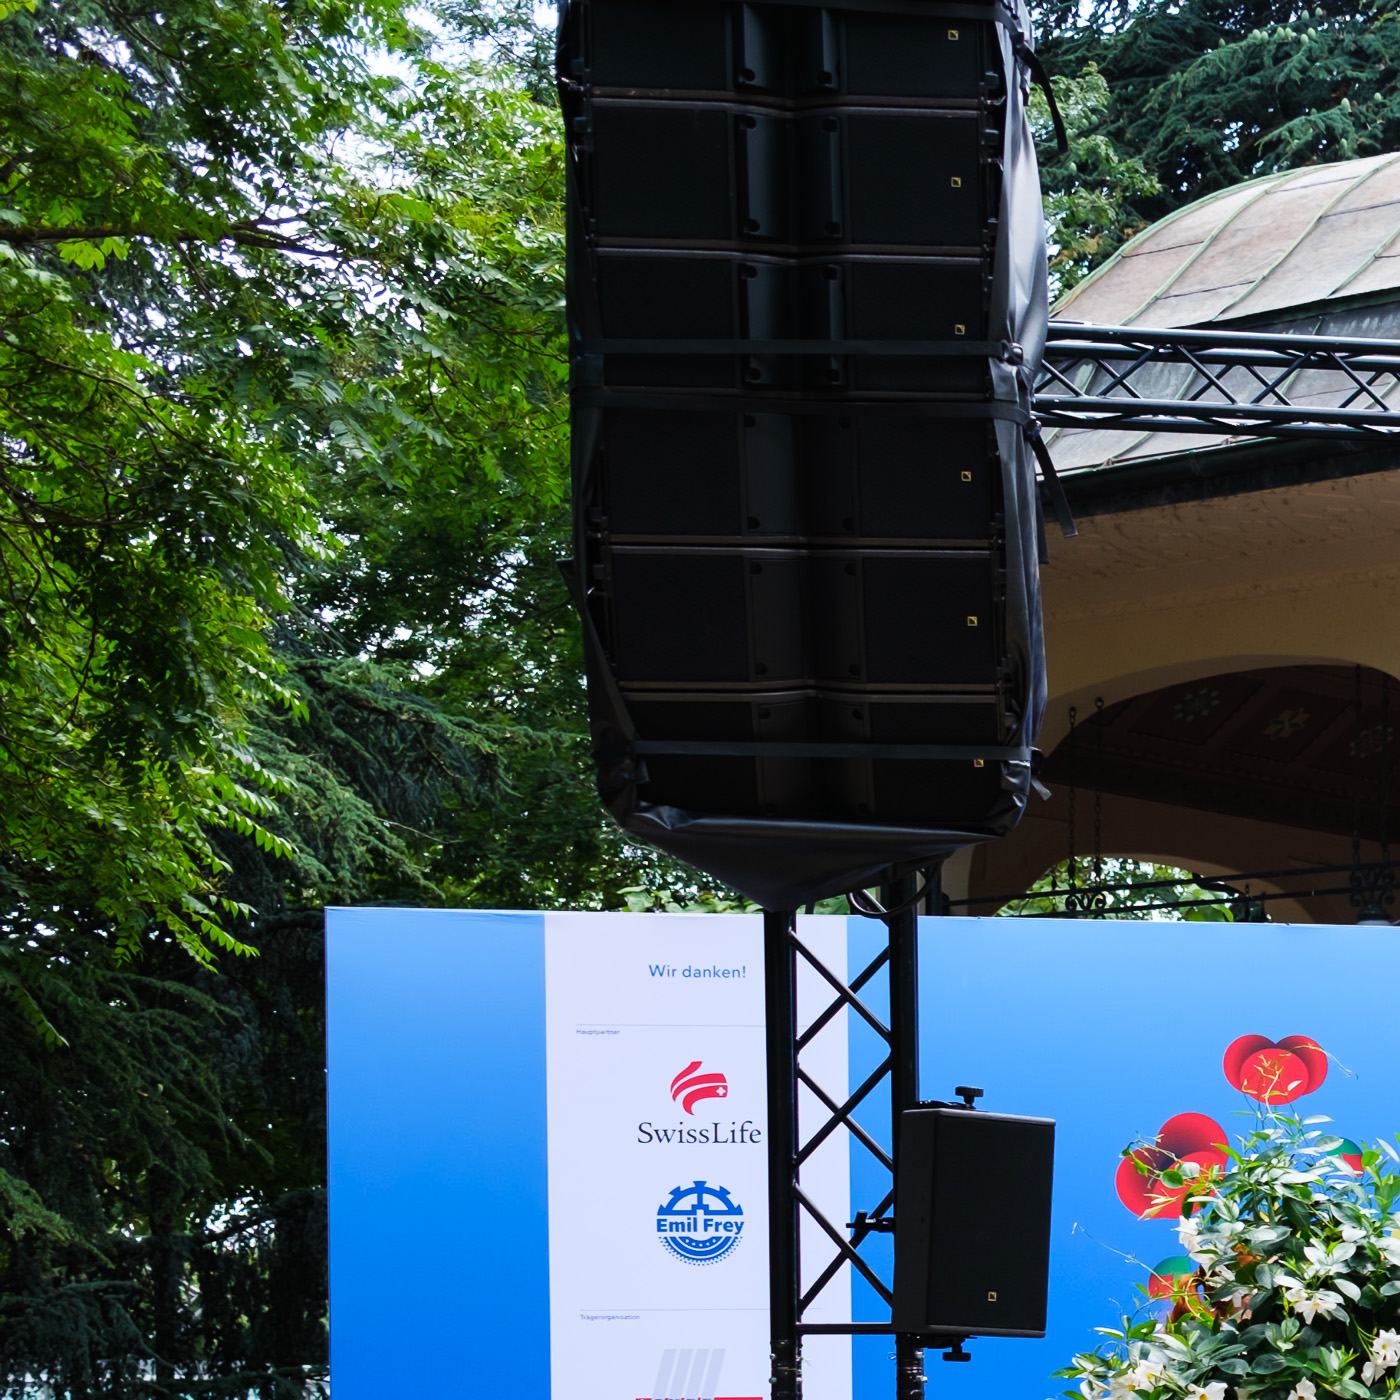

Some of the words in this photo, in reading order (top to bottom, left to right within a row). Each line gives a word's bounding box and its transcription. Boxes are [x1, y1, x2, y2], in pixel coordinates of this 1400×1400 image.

[648, 964, 678, 978] Wir
[682, 965, 746, 978] danken!
[637, 1120, 762, 1144] SwissLife
[656, 1217, 697, 1232] Emil
[703, 1218, 745, 1235] Frey
